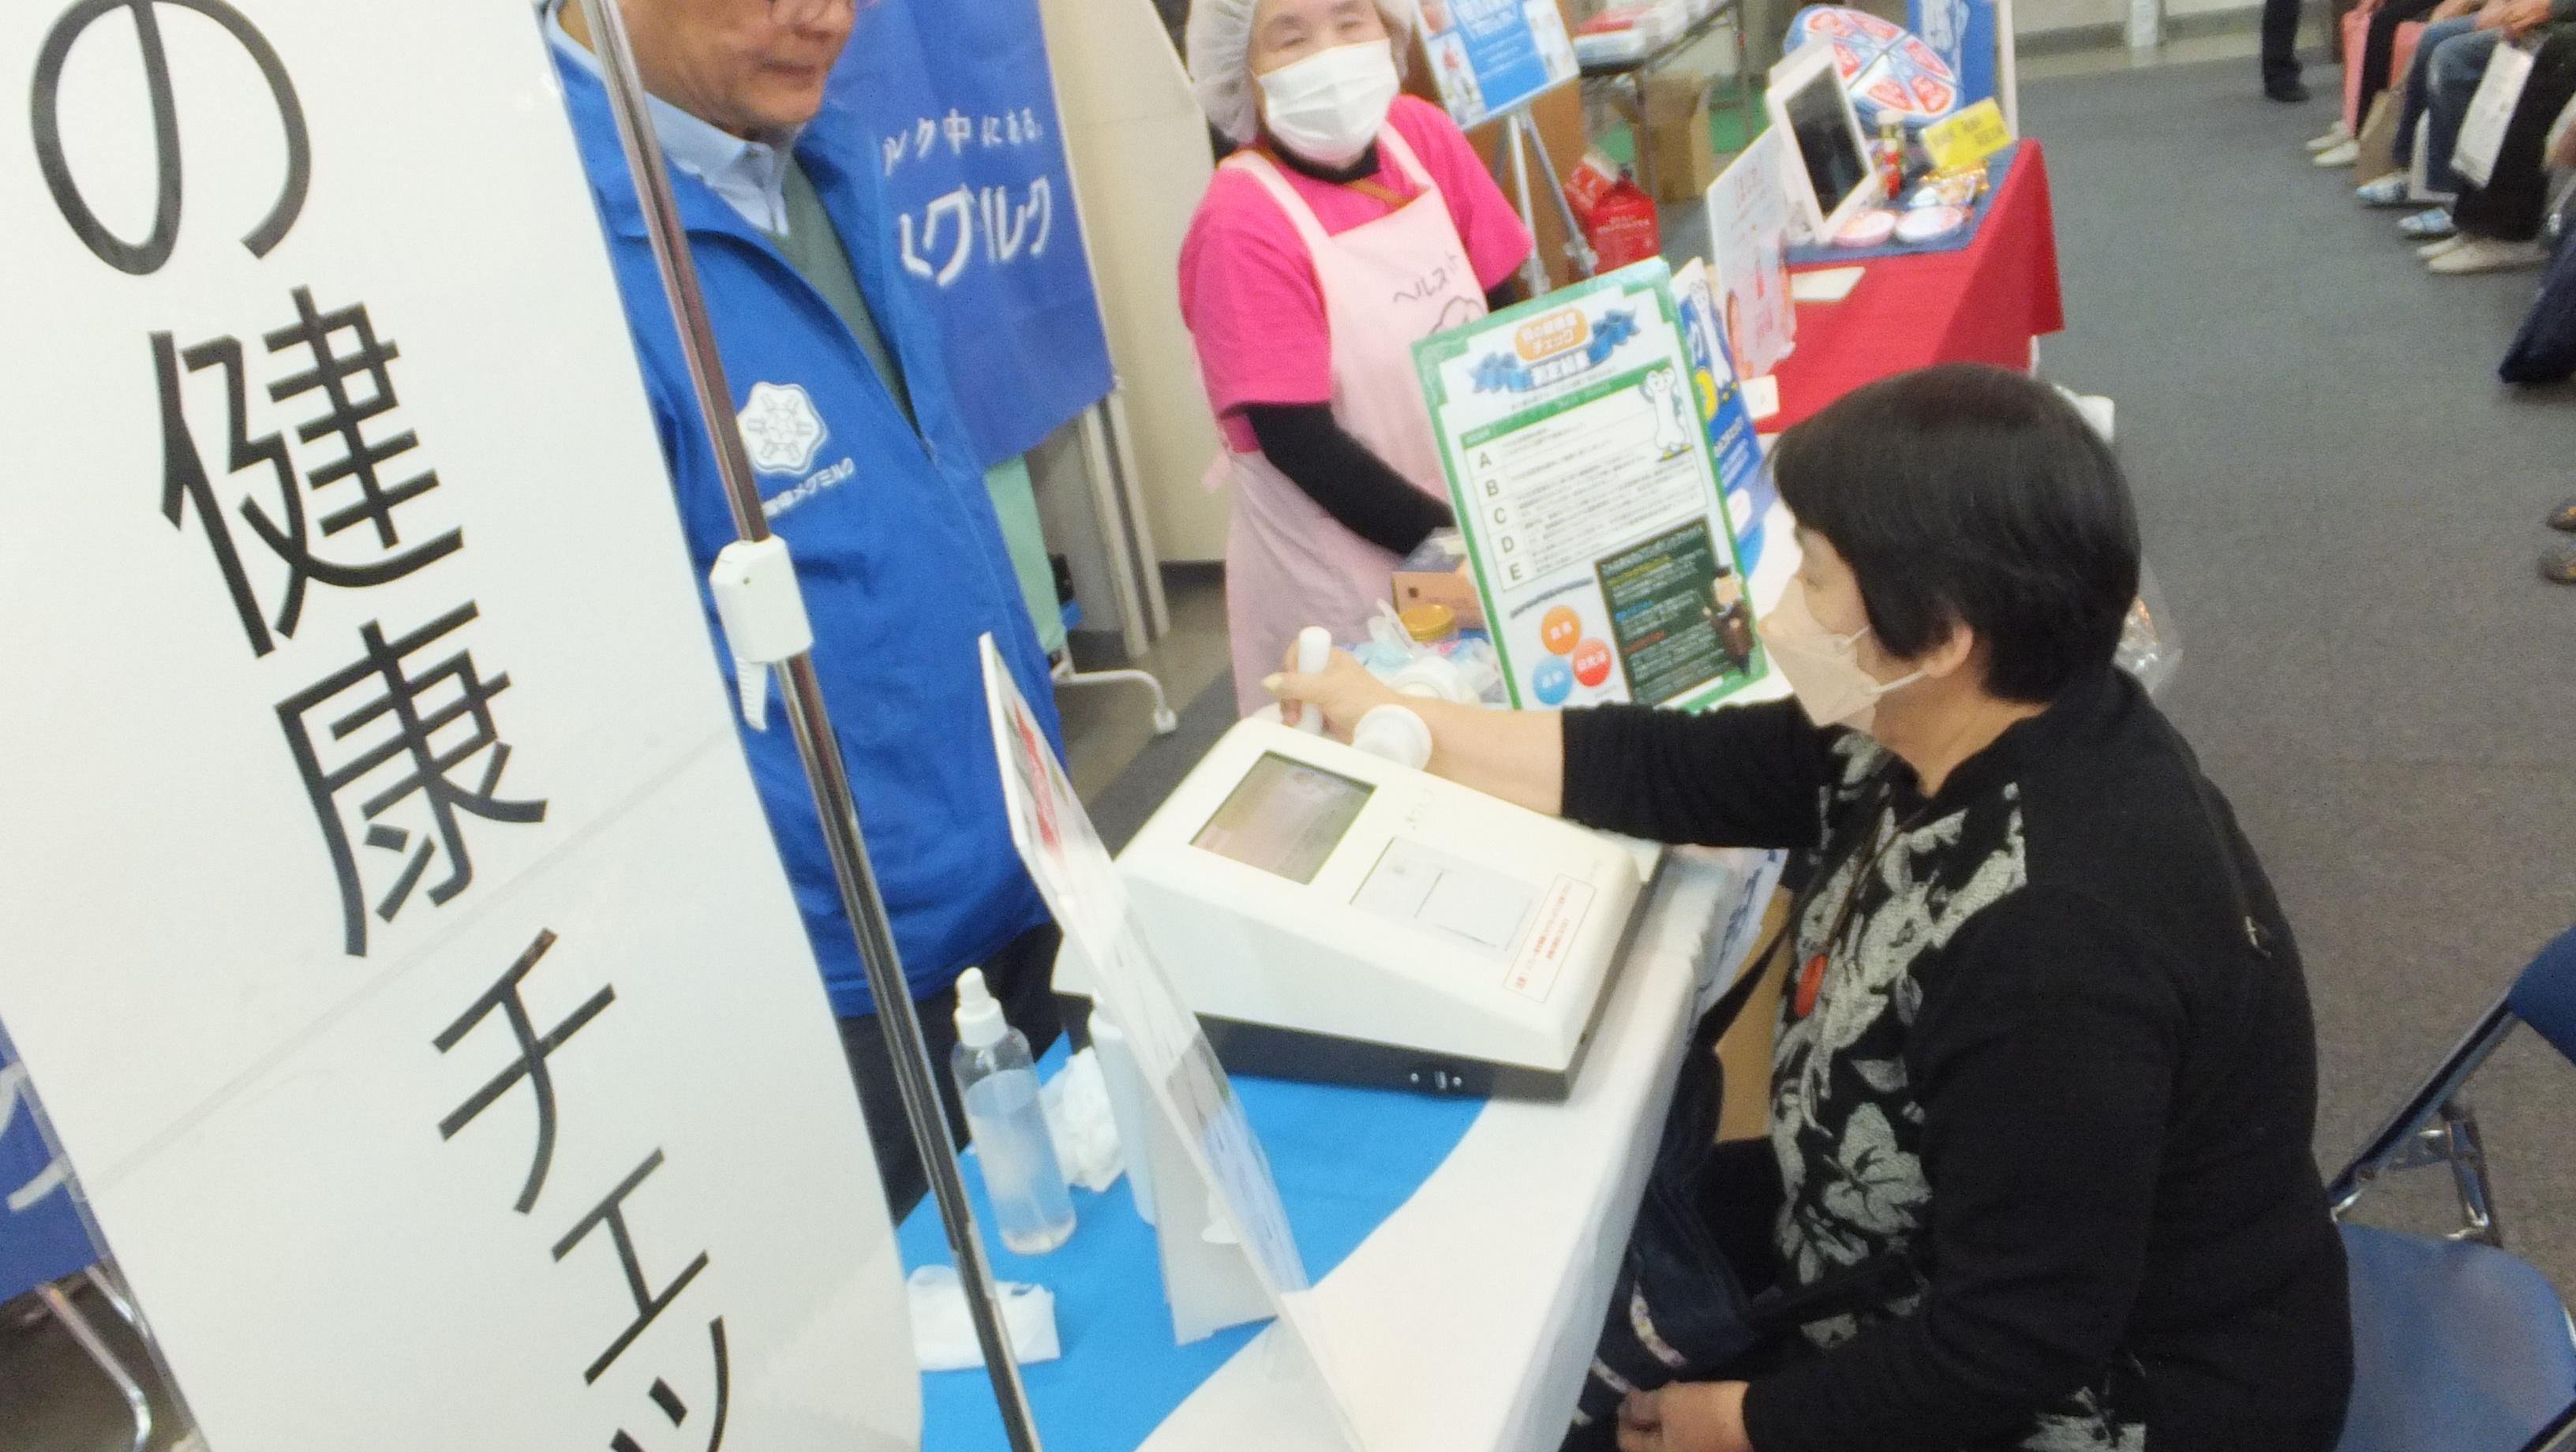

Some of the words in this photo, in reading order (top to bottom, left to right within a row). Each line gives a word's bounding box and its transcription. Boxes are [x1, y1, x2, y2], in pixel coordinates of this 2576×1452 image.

[1479, 451, 1492, 468] A
[1485, 479, 1500, 498] B
[1493, 507, 1507, 525] C
[1501, 536, 1515, 554] D
[1509, 563, 1522, 582] E
